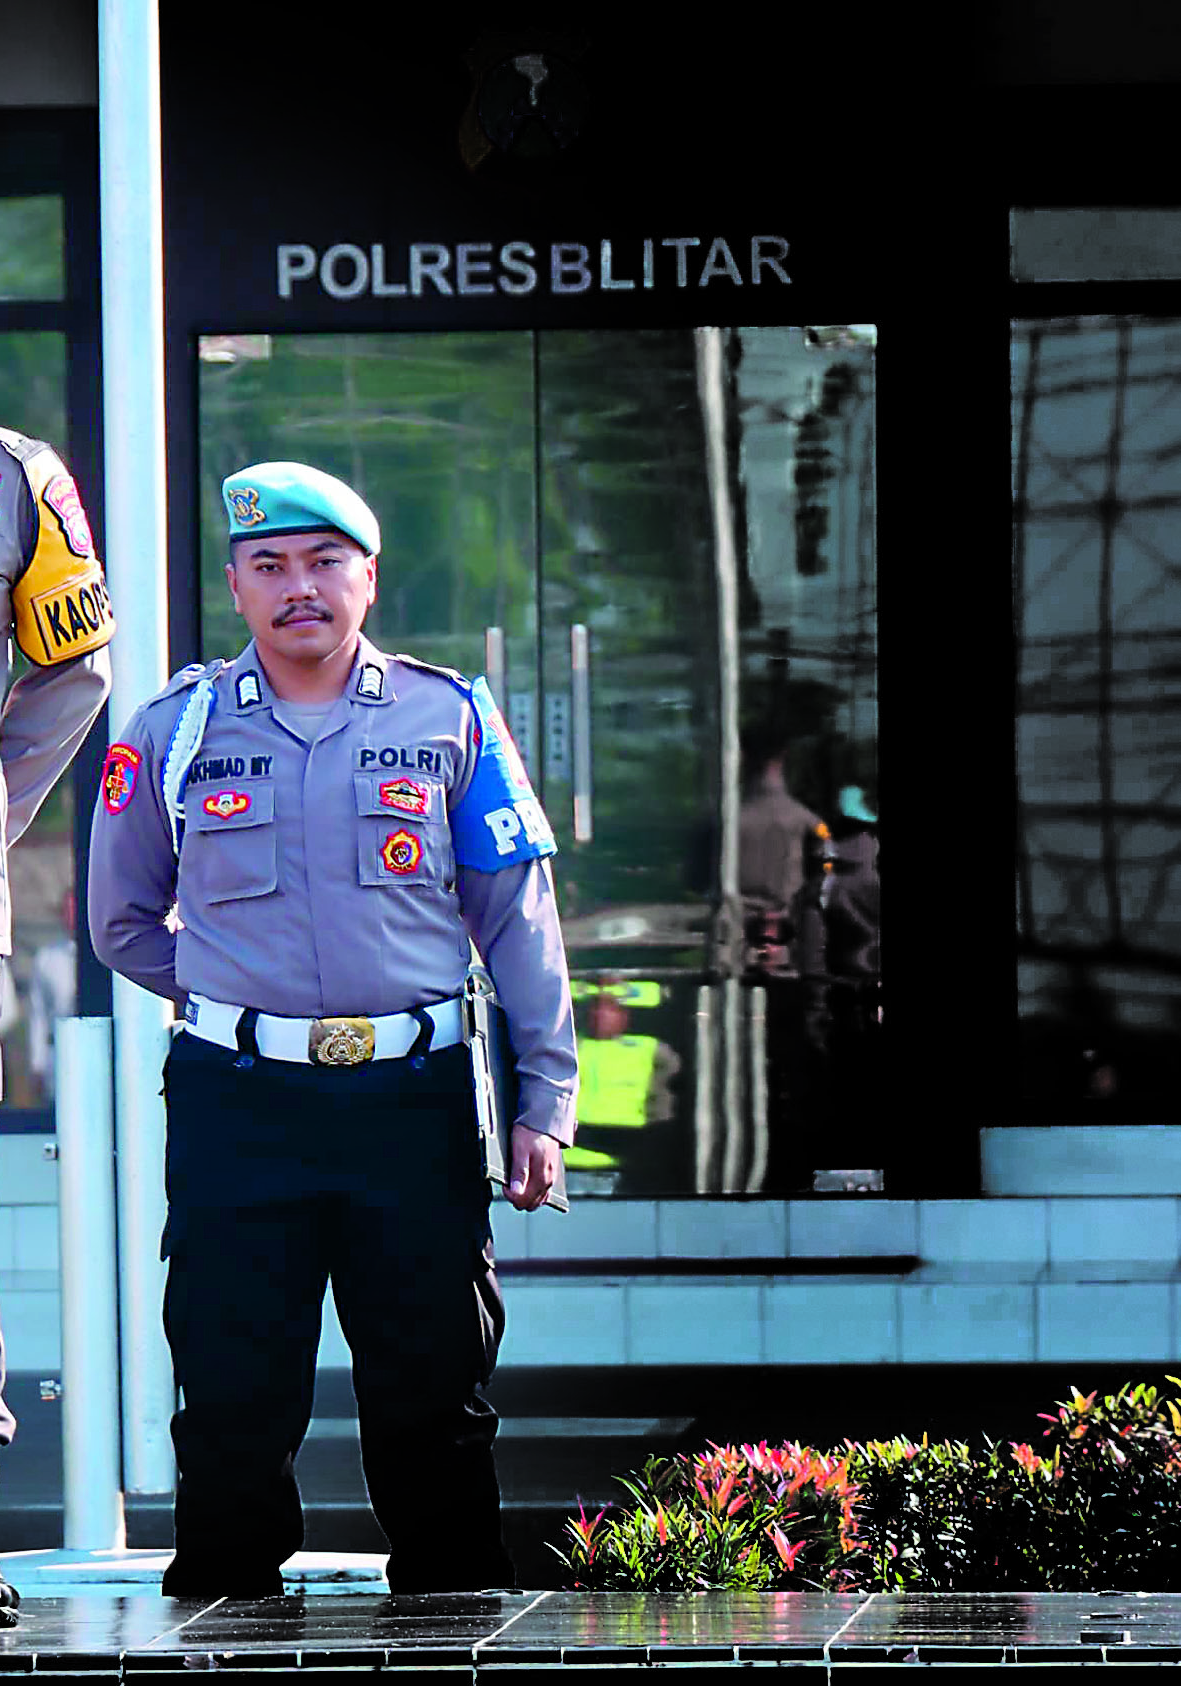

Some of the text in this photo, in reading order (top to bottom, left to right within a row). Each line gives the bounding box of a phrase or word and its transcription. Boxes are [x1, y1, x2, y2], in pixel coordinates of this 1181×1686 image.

[277, 236, 793, 298] POLRES BLITAR
[360, 747, 442, 773] POLRI
